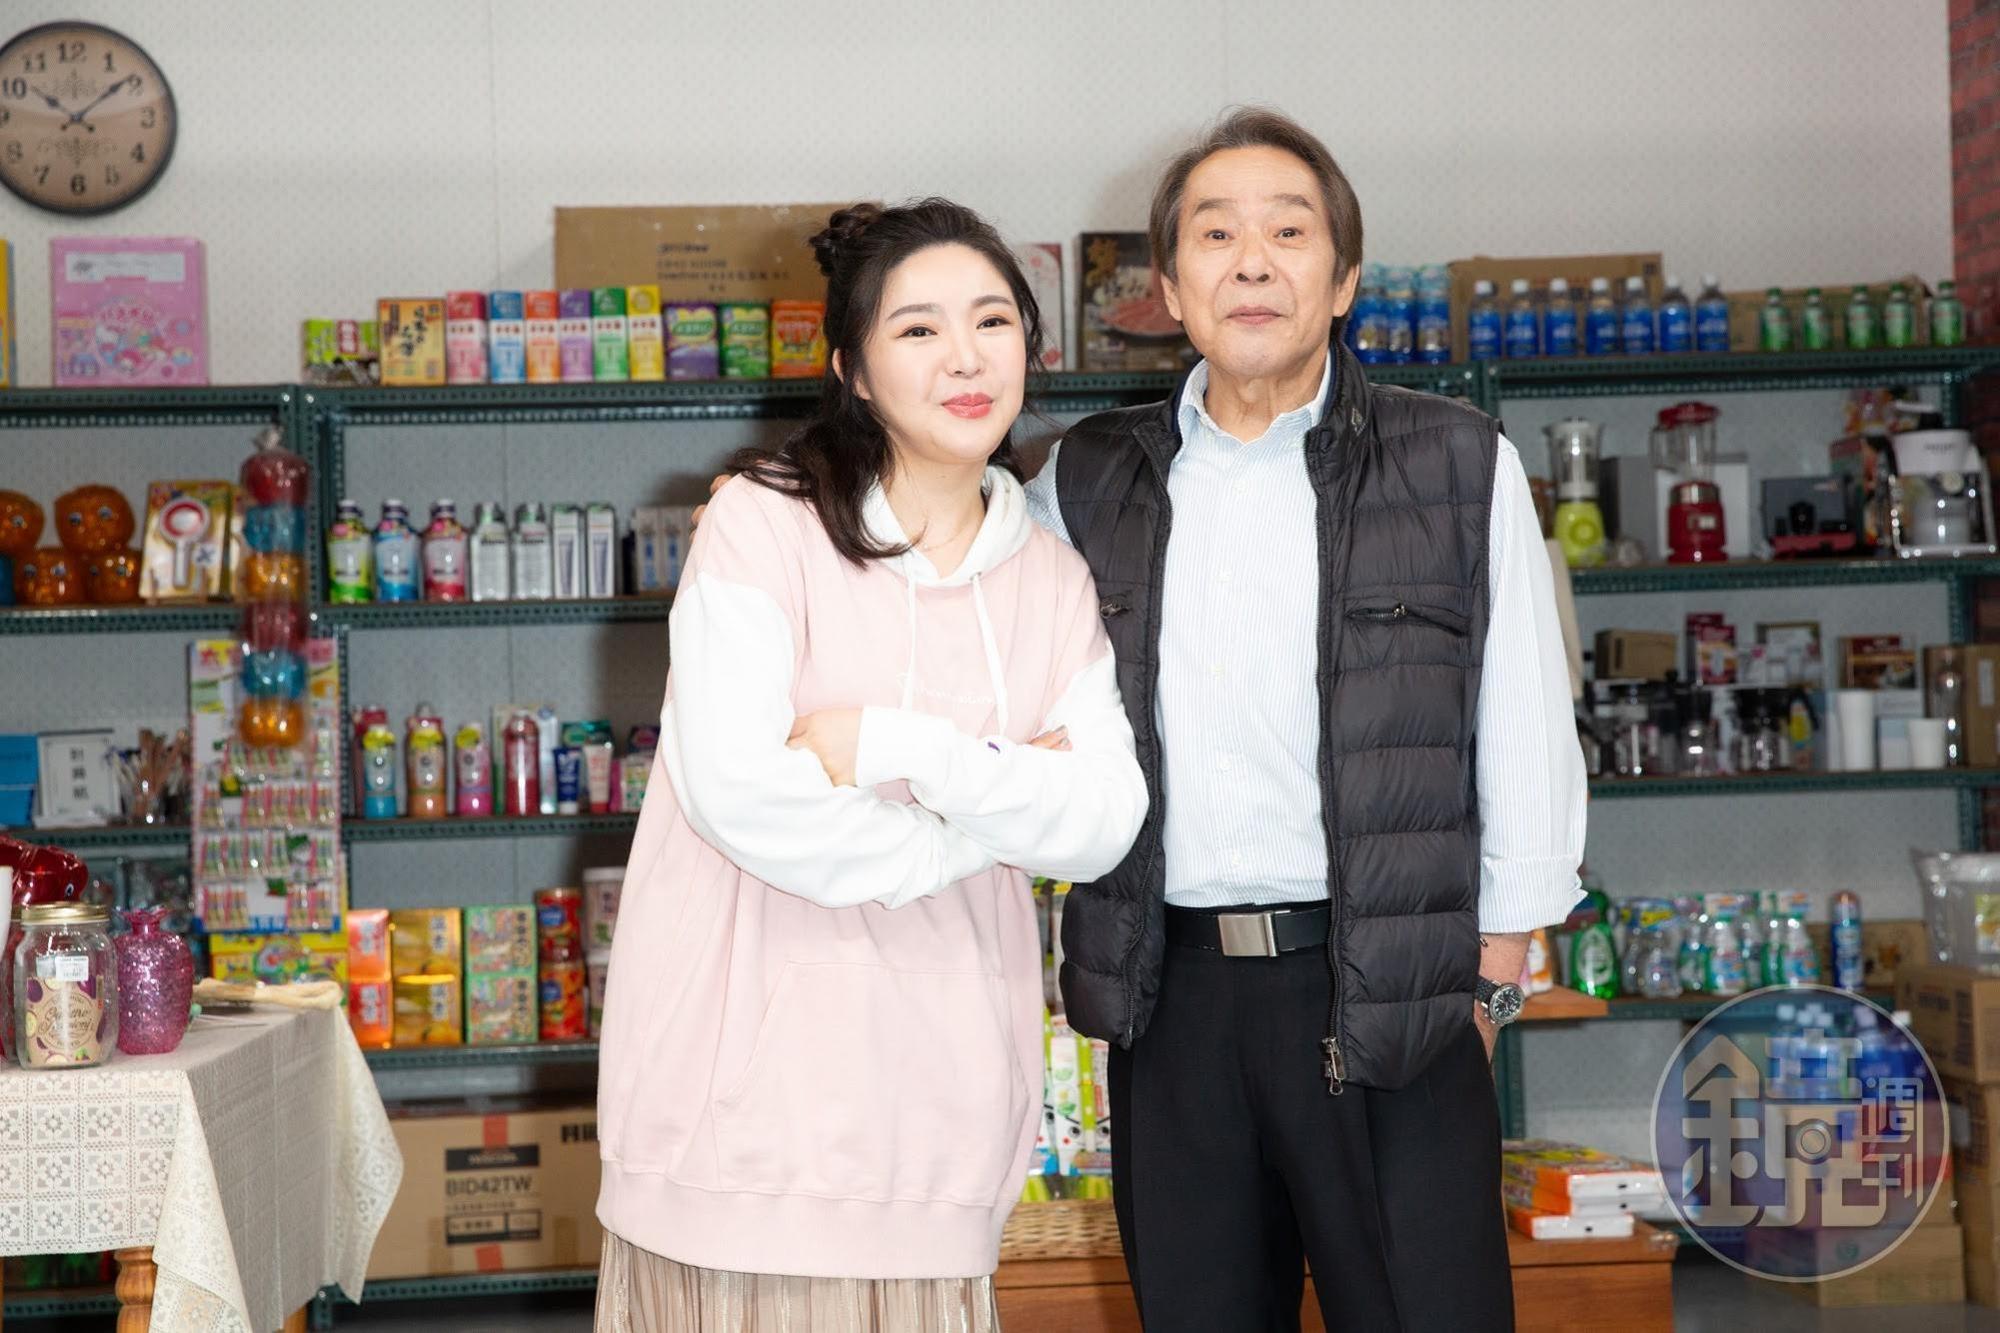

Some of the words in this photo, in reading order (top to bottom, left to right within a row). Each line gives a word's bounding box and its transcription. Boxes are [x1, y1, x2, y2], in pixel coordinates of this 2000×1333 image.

[22, 51, 47, 73] 11
[57, 41, 87, 64] 12
[103, 52, 117, 73] 1
[1, 77, 27, 98] 10
[126, 74, 144, 97] 2
[140, 105, 156, 129] 3
[5, 140, 23, 164] 8
[130, 142, 146, 164] 4
[34, 163, 50, 185] 7
[70, 173, 87, 195] 6
[105, 163, 120, 186] 5
